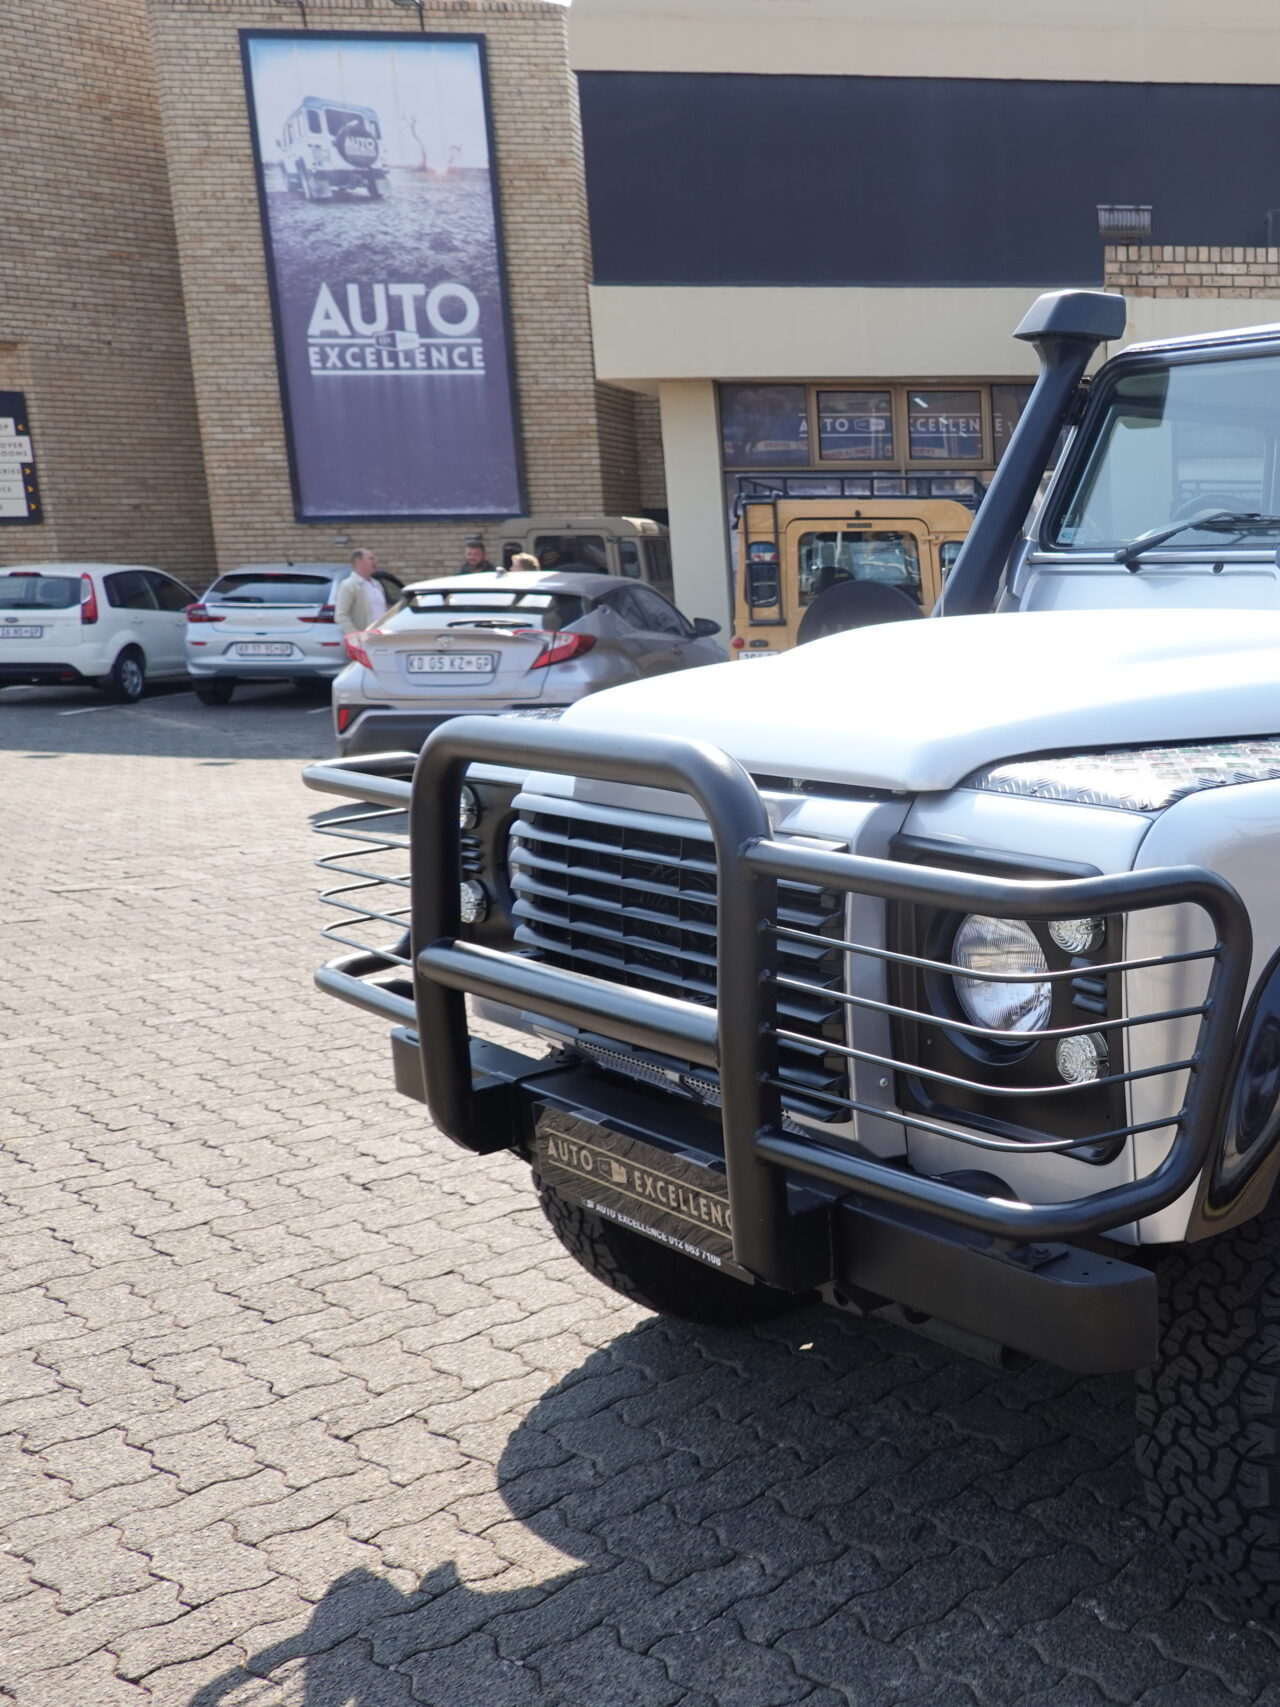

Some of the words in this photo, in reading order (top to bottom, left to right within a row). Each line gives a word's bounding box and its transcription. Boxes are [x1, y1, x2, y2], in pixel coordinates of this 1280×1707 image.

[307, 282, 480, 337] AUTO
[308, 346, 486, 369] EXCELLENCE
[799, 418, 849, 432] ATO
[910, 418, 1003, 432] CELLENE
[475, 657, 490, 670] GP
[547, 1137, 593, 1171] AUTO
[634, 1171, 734, 1230] EXCELLENC
[596, 1203, 616, 1218] AUTO
[617, 1212, 667, 1242] EXCELLENCE
